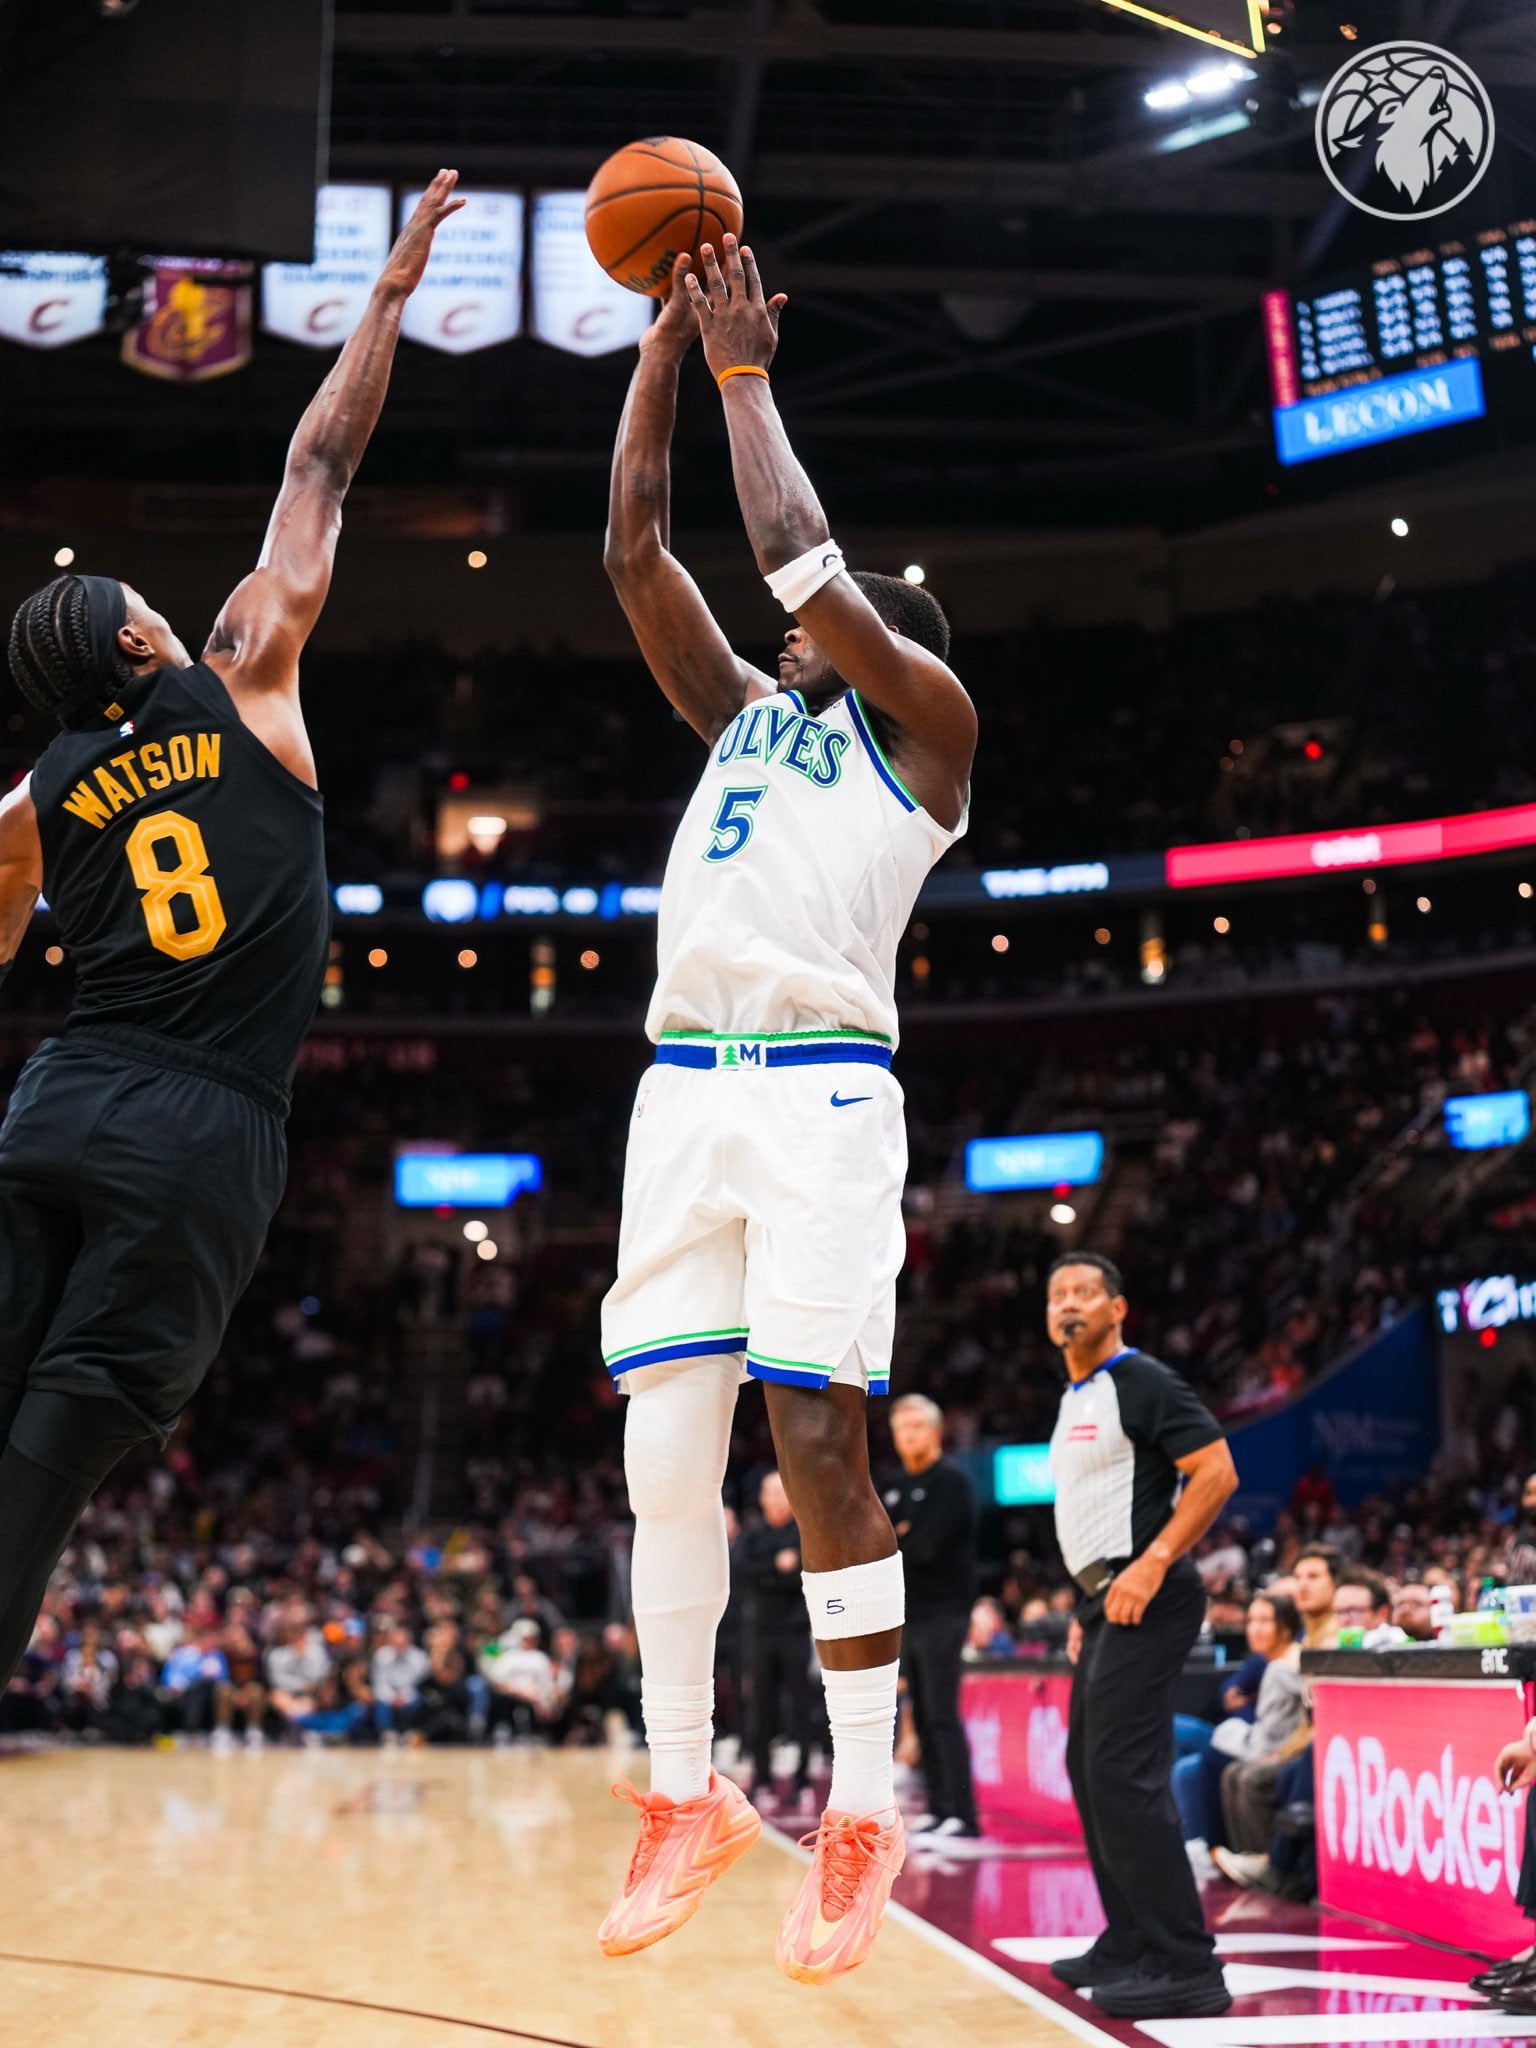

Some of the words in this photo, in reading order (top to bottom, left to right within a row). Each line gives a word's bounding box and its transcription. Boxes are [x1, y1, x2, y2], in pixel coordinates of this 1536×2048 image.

[62, 733, 221, 829] WATSON
[716, 705, 851, 788] OLVES
[701, 785, 769, 863] 5
[125, 810, 227, 961] 8
[739, 1043, 761, 1065] M
[826, 1598, 845, 1615] 5
